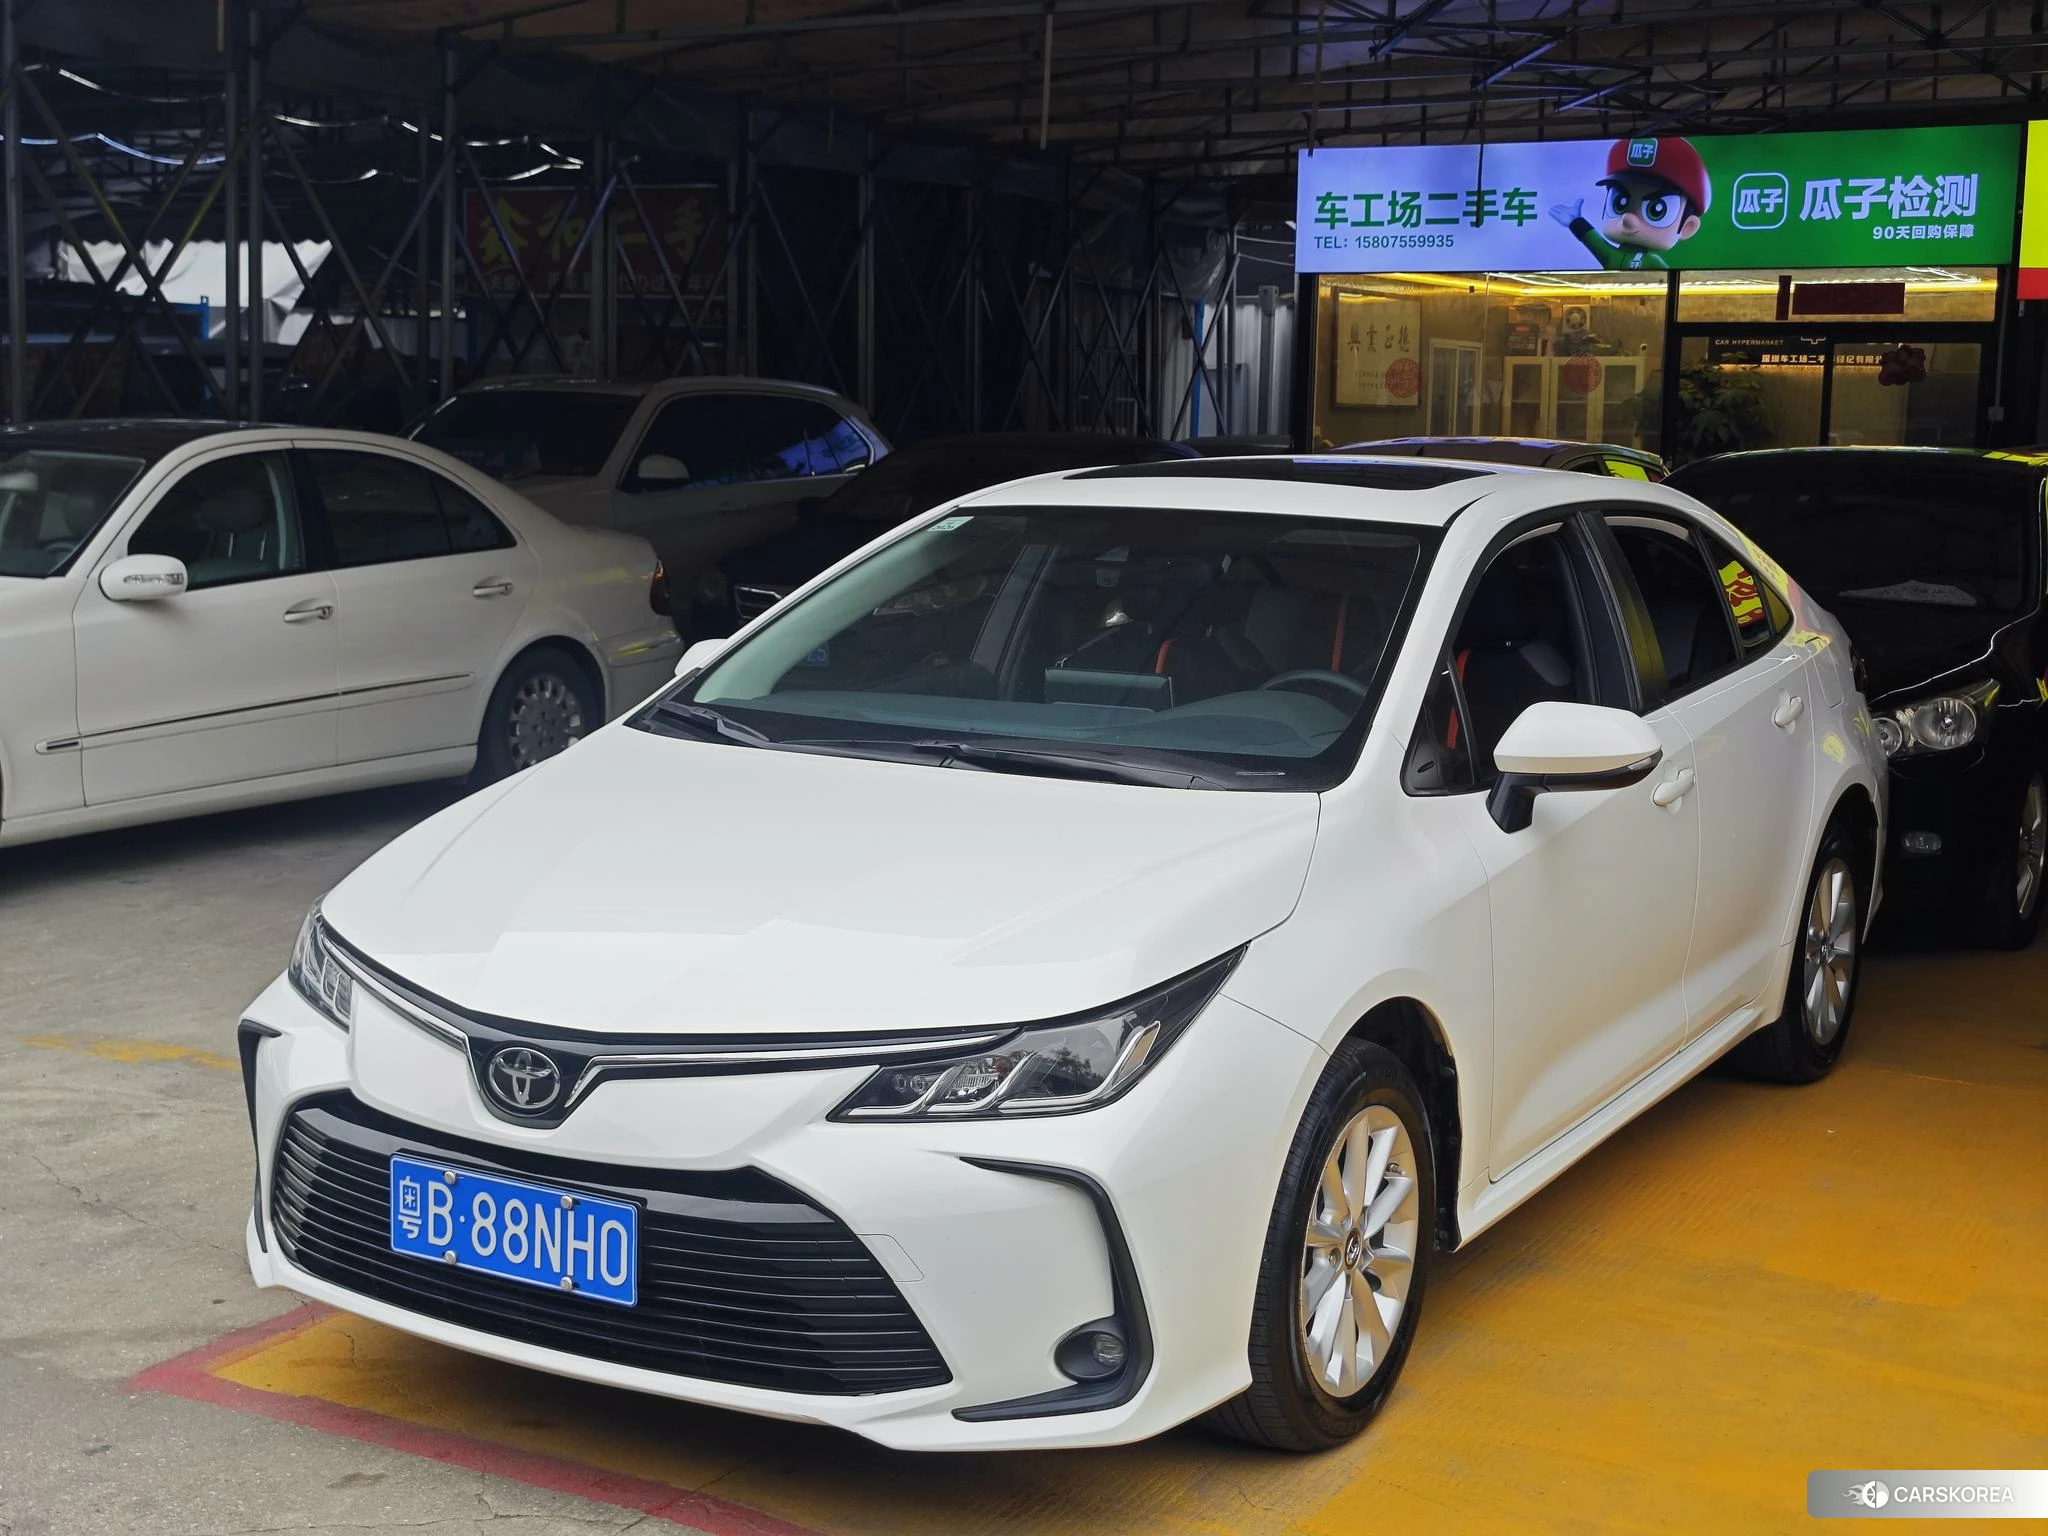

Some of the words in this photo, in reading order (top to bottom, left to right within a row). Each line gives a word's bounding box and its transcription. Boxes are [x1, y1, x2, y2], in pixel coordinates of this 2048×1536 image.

[1630, 143, 1654, 159] 瓜子
[1737, 188, 1784, 214] 瓜子
[1799, 173, 1979, 221] 瓜子检测
[1314, 187, 1538, 230] 车工场二手车
[1355, 234, 1454, 248] 15807559935
[1872, 224, 1975, 240] 90天回购保障
